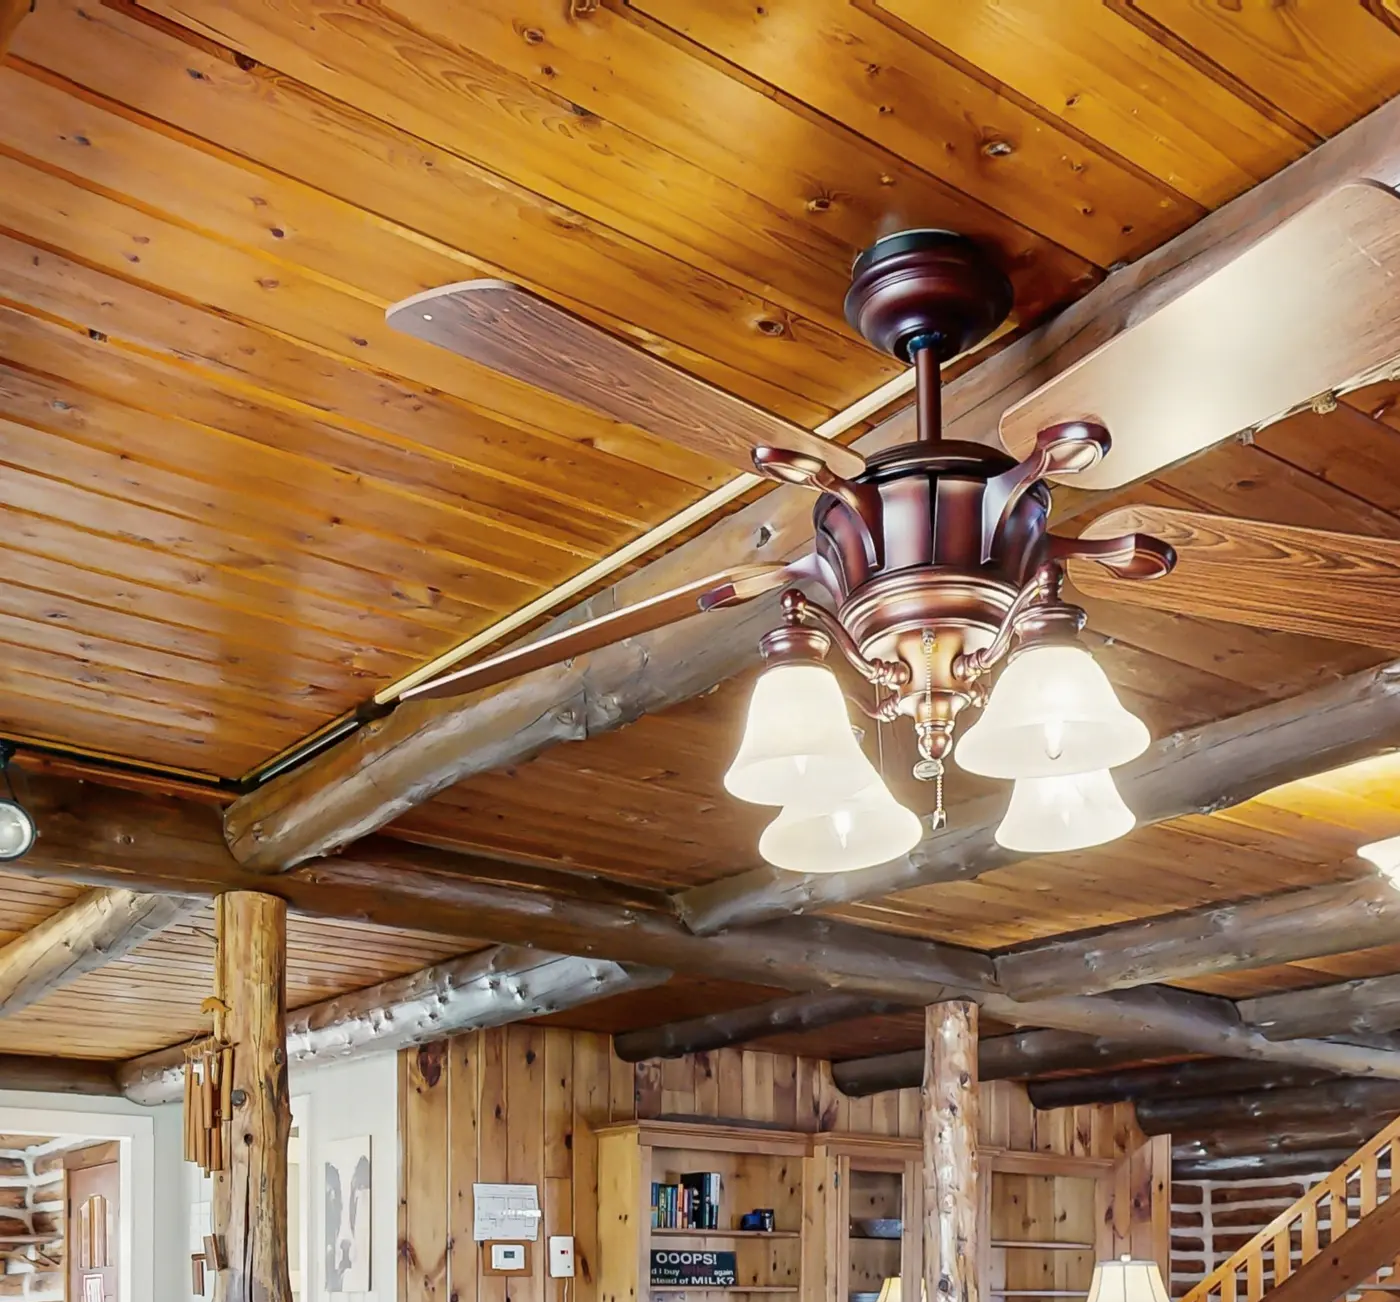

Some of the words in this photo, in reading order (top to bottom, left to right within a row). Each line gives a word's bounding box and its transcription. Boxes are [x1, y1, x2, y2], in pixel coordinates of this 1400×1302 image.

[656, 1252, 717, 1265] OOOPS!
[664, 1268, 680, 1276] buy
[691, 1276, 735, 1285] MILK?
